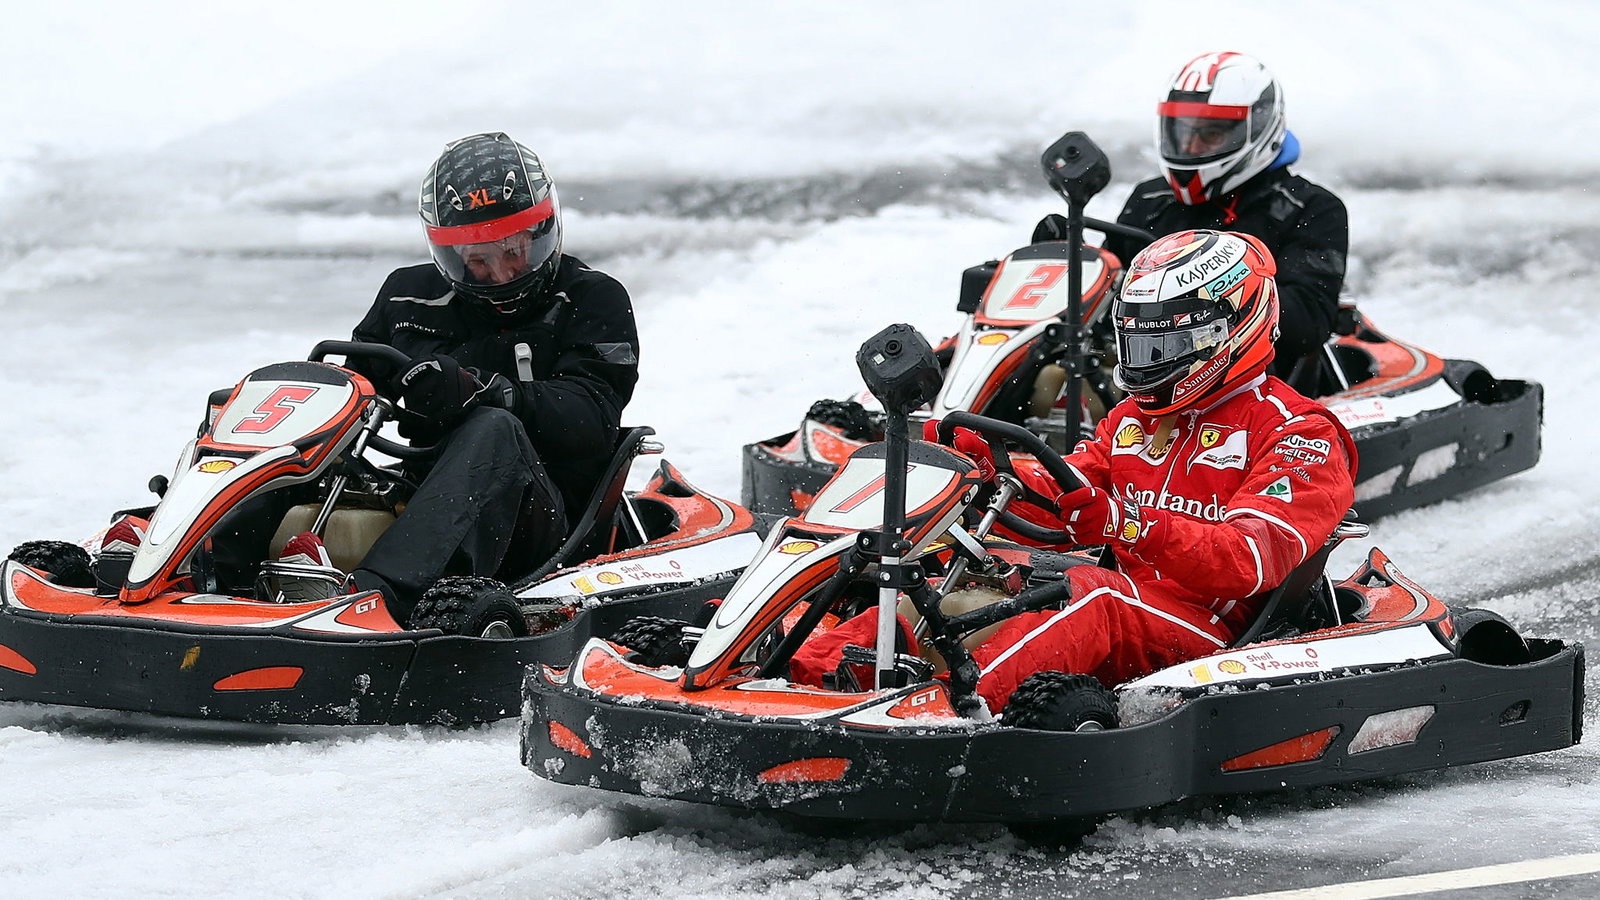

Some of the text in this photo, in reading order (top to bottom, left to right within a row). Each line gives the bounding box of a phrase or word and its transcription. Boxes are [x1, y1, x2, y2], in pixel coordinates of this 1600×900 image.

[468, 189, 497, 209] XL
[1175, 243, 1234, 288] KASPERSKY
[1004, 264, 1069, 308] 2
[1210, 268, 1249, 297] Riva
[1138, 320, 1171, 329] HUBLOT
[1184, 355, 1227, 389] Santander
[231, 384, 321, 434] 5
[1274, 446, 1327, 465] WEICHAI
[1126, 483, 1228, 522] Santande
[620, 563, 645, 574] Shell
[627, 570, 685, 581] V-Power
[355, 597, 379, 614] GT
[1246, 652, 1274, 663] Shell
[1253, 659, 1320, 671] V-Power
[911, 688, 940, 707] GT
